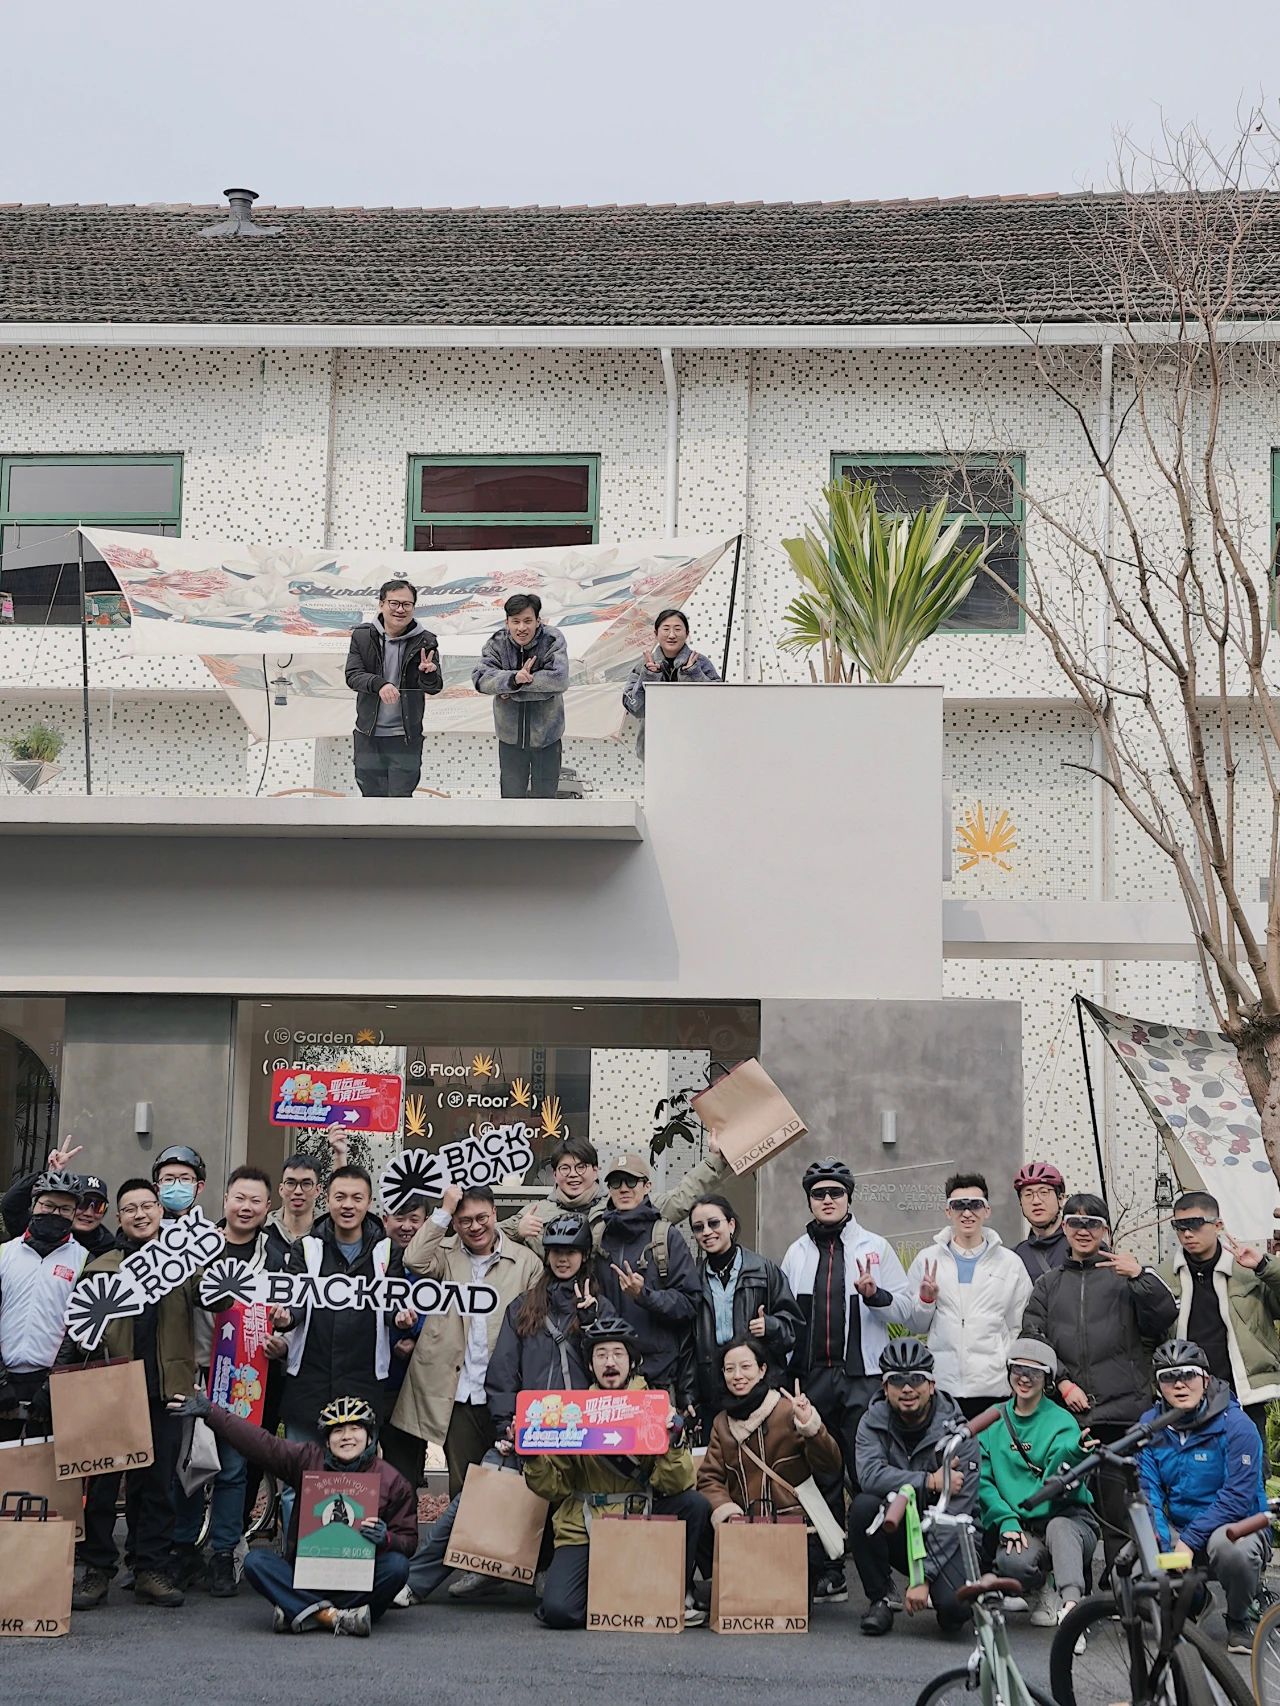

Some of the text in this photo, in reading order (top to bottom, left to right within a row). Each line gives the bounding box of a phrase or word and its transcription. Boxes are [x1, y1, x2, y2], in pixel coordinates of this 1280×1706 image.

[289, 580, 380, 599] Saturda
[293, 1030, 354, 1044] Garden
[429, 1063, 471, 1077] Floor
[467, 1095, 509, 1108] Floor
[443, 1126, 526, 1169] BACK
[450, 1149, 531, 1187] ROAD
[862, 1183, 896, 1193] ROAD
[124, 1210, 210, 1282] BACK
[141, 1232, 222, 1299] ROAD
[267, 1275, 498, 1314] BACKROAD
[333, 1475, 351, 1485] WITH
